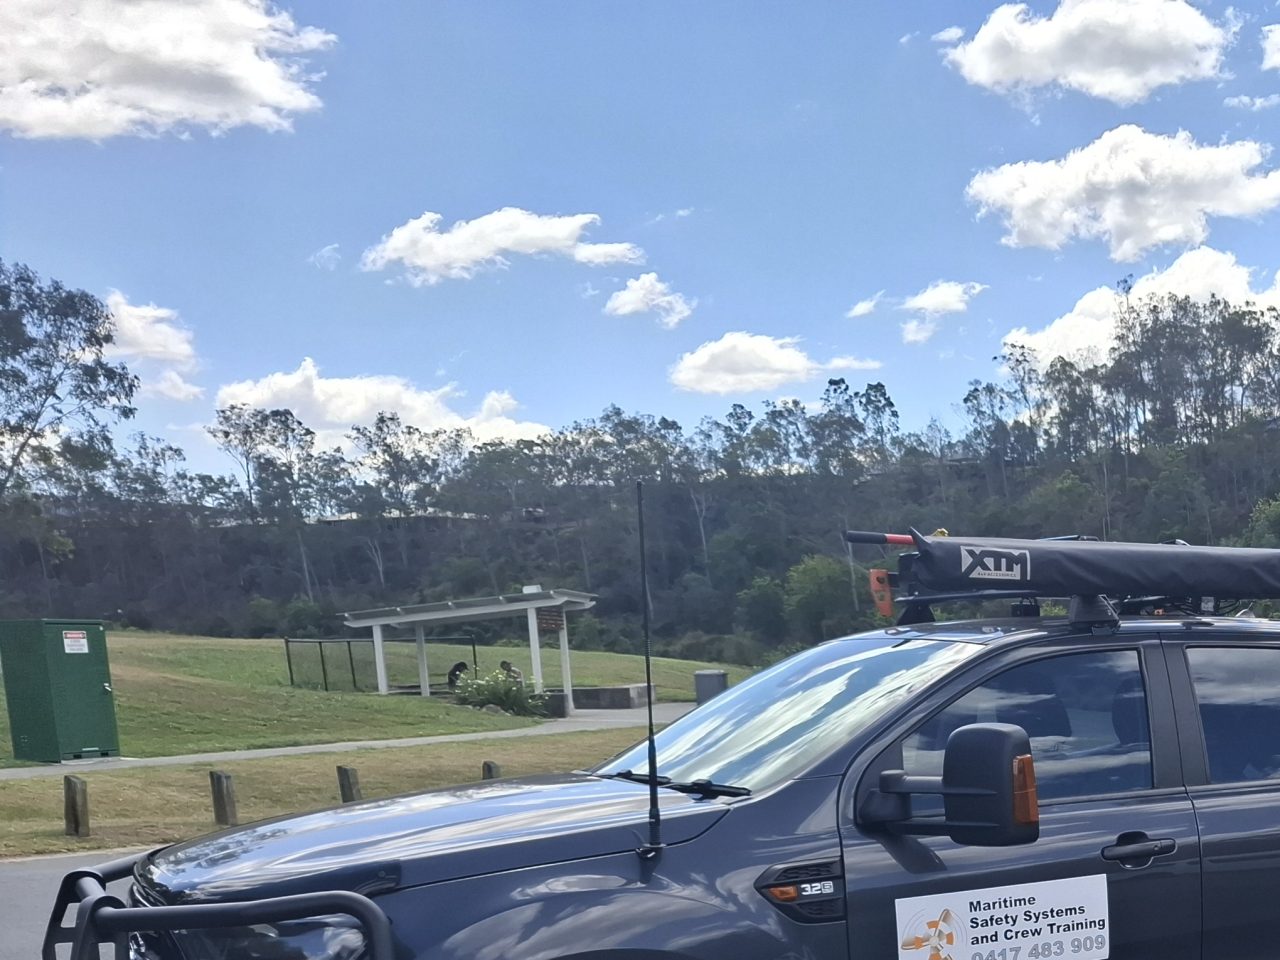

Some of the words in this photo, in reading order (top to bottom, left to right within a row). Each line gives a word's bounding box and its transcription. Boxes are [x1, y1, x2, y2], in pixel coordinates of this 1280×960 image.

[961, 548, 1028, 580] XTM
[969, 896, 1036, 912] Maritime
[970, 913, 1018, 928] Safety
[1023, 905, 1085, 922] Systems
[971, 931, 998, 945] and
[1003, 925, 1043, 941] Crew
[1047, 918, 1106, 934] Training
[1027, 940, 1065, 960] 483
[1070, 934, 1107, 954] 909
